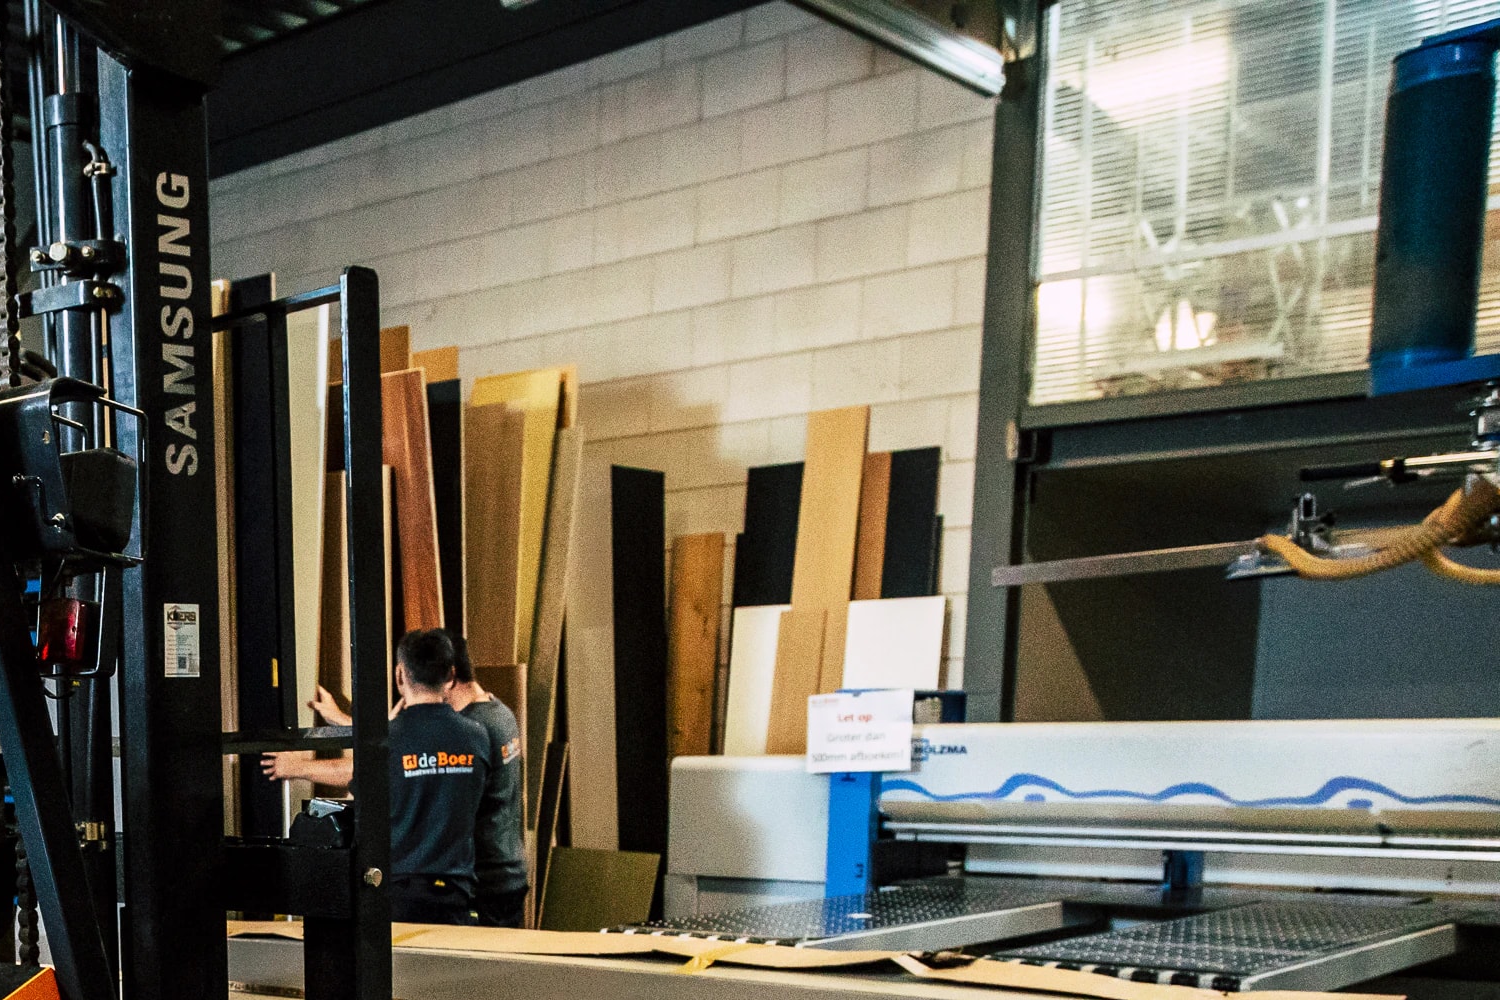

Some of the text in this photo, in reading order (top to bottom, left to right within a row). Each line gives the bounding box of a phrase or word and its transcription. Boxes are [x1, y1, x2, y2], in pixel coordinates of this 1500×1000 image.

[156, 171, 198, 477] SAMSUNG
[838, 714, 873, 723] Let op
